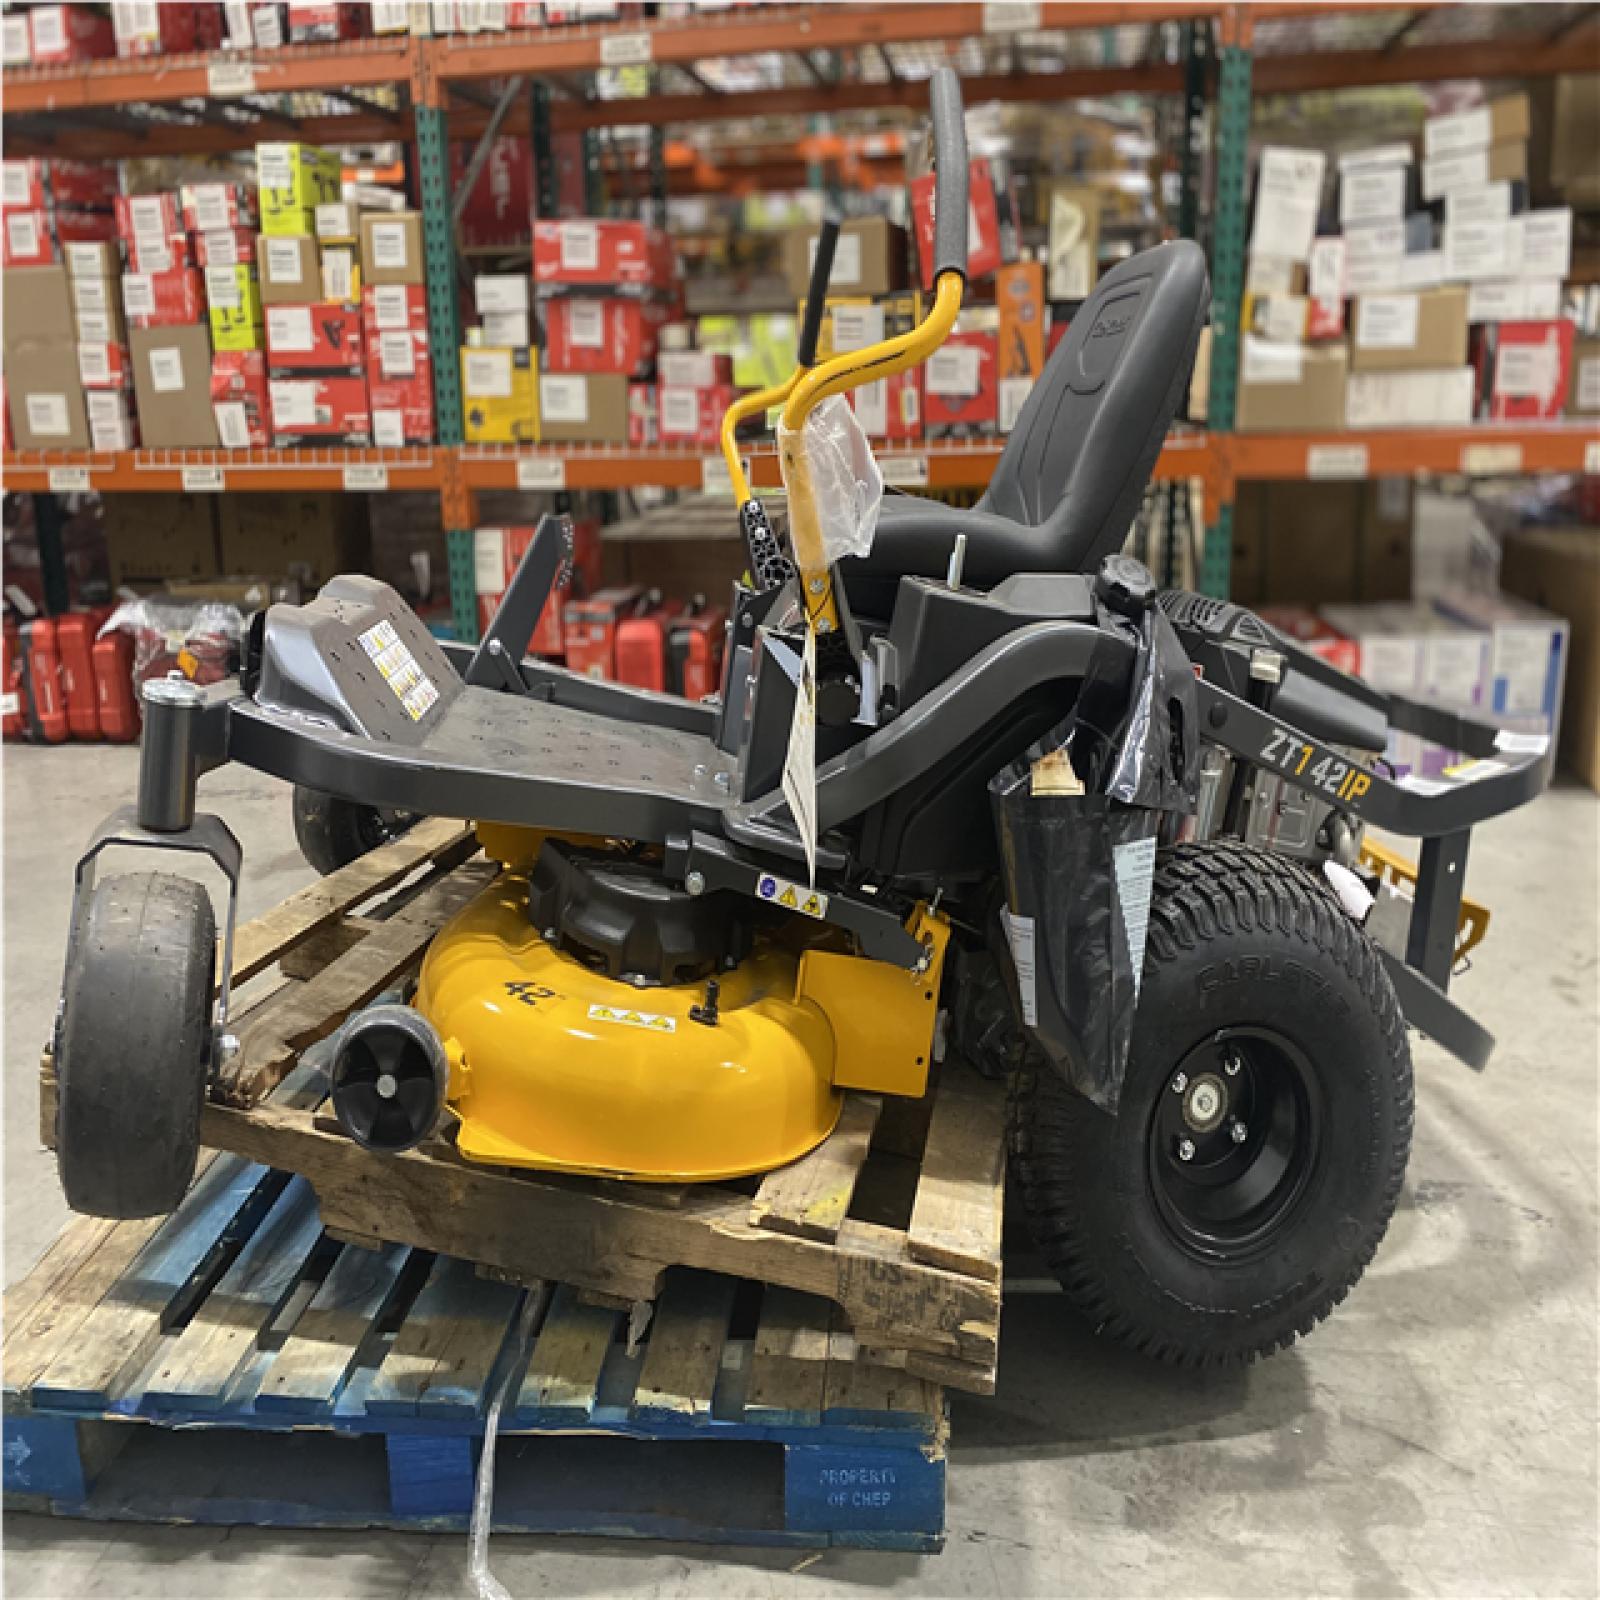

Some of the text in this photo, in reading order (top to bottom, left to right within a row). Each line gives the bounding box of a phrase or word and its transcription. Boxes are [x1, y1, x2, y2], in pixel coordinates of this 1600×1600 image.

[1260, 727, 1371, 801] ZT1 42IP
[827, 1491, 891, 1507] OF CHEP
